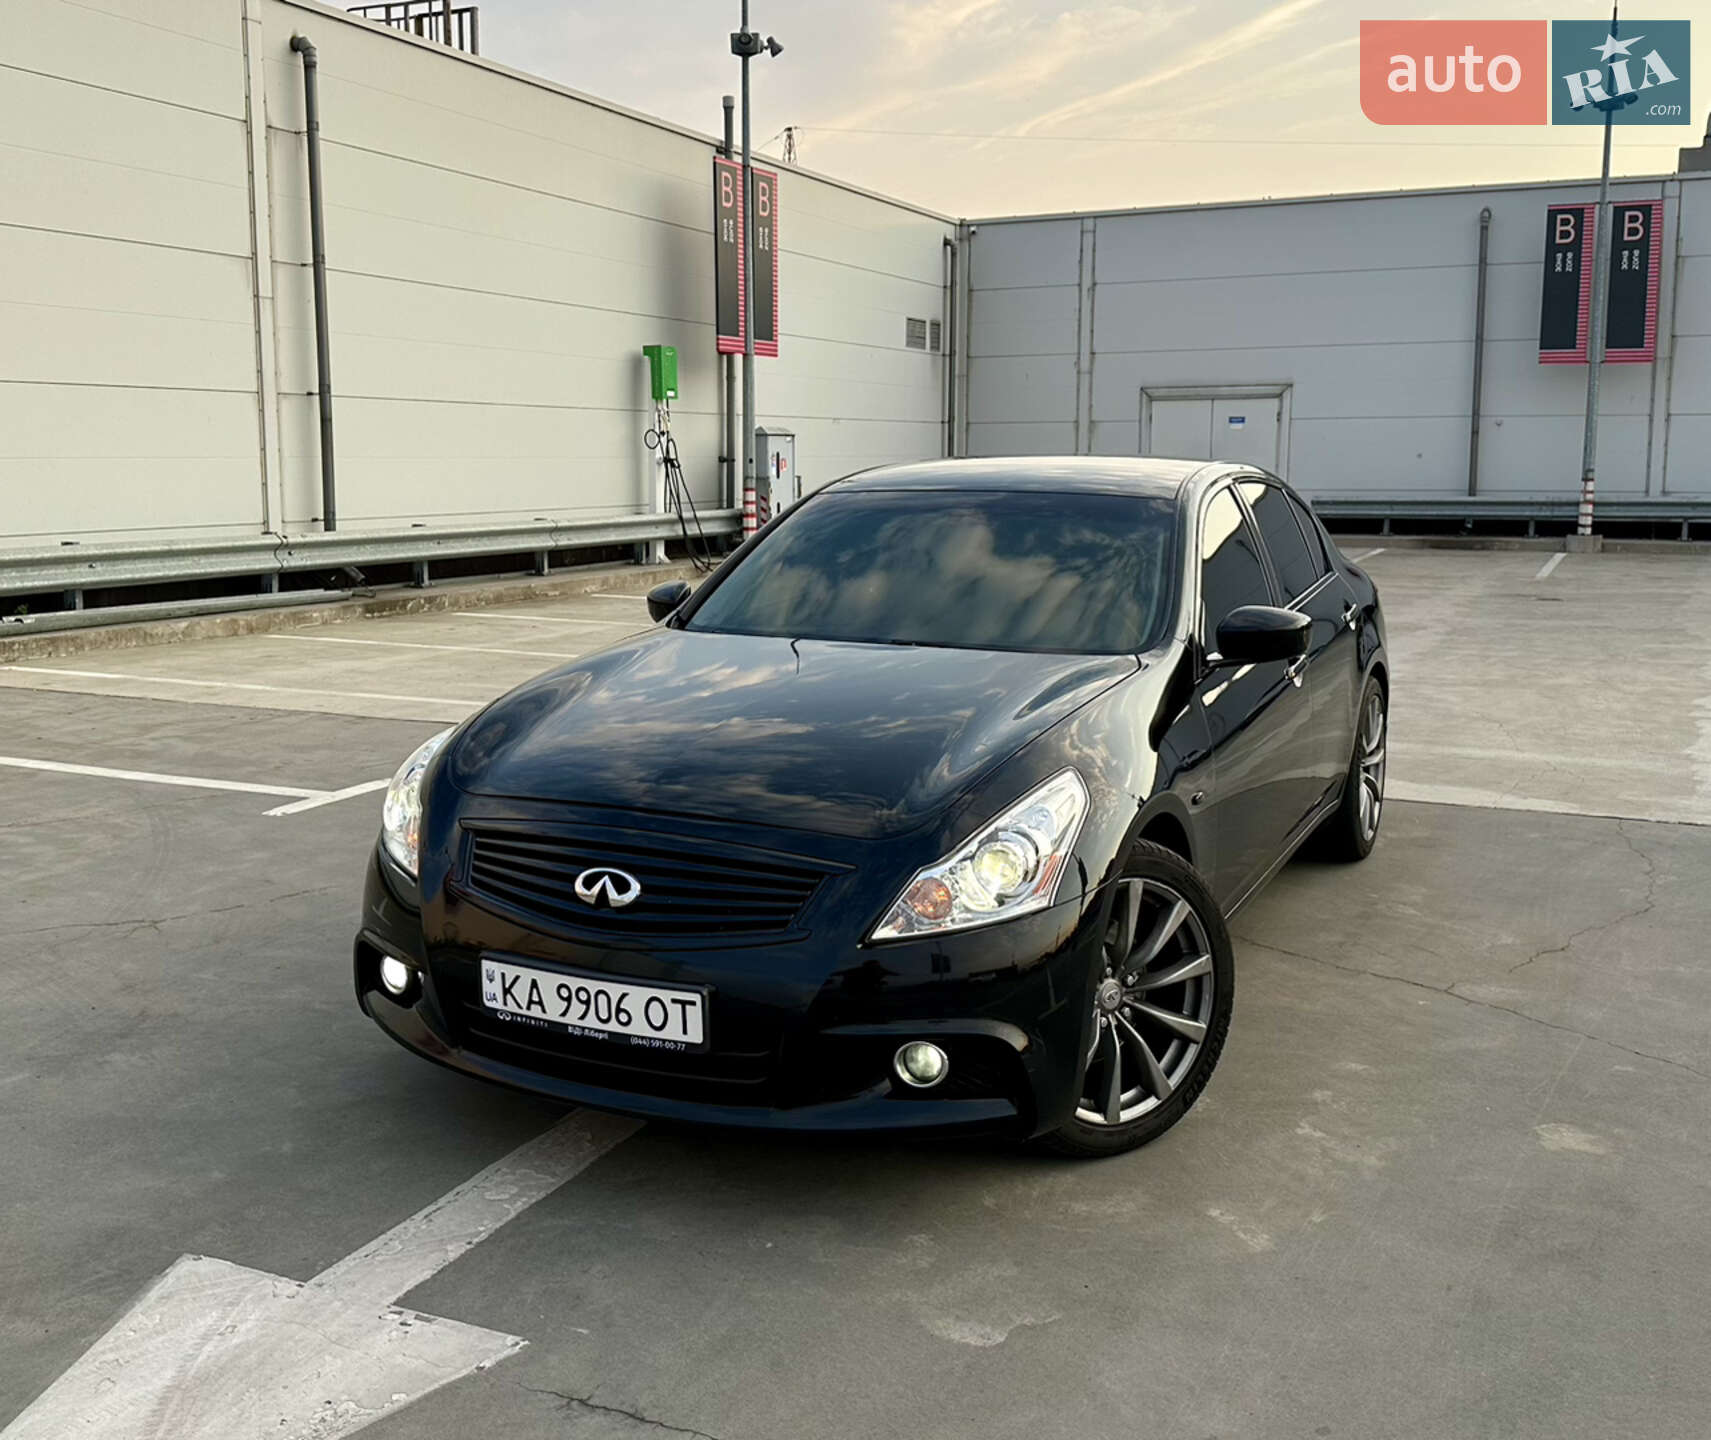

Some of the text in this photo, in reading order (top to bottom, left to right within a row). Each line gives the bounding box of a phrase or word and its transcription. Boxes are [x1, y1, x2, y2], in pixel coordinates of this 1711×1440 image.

[721, 171, 733, 208] B
[759, 181, 770, 216] B
[1555, 214, 1576, 244] B
[1623, 210, 1645, 241] B
[485, 992, 498, 1003] UA
[500, 972, 697, 1035] KA 9906 OT
